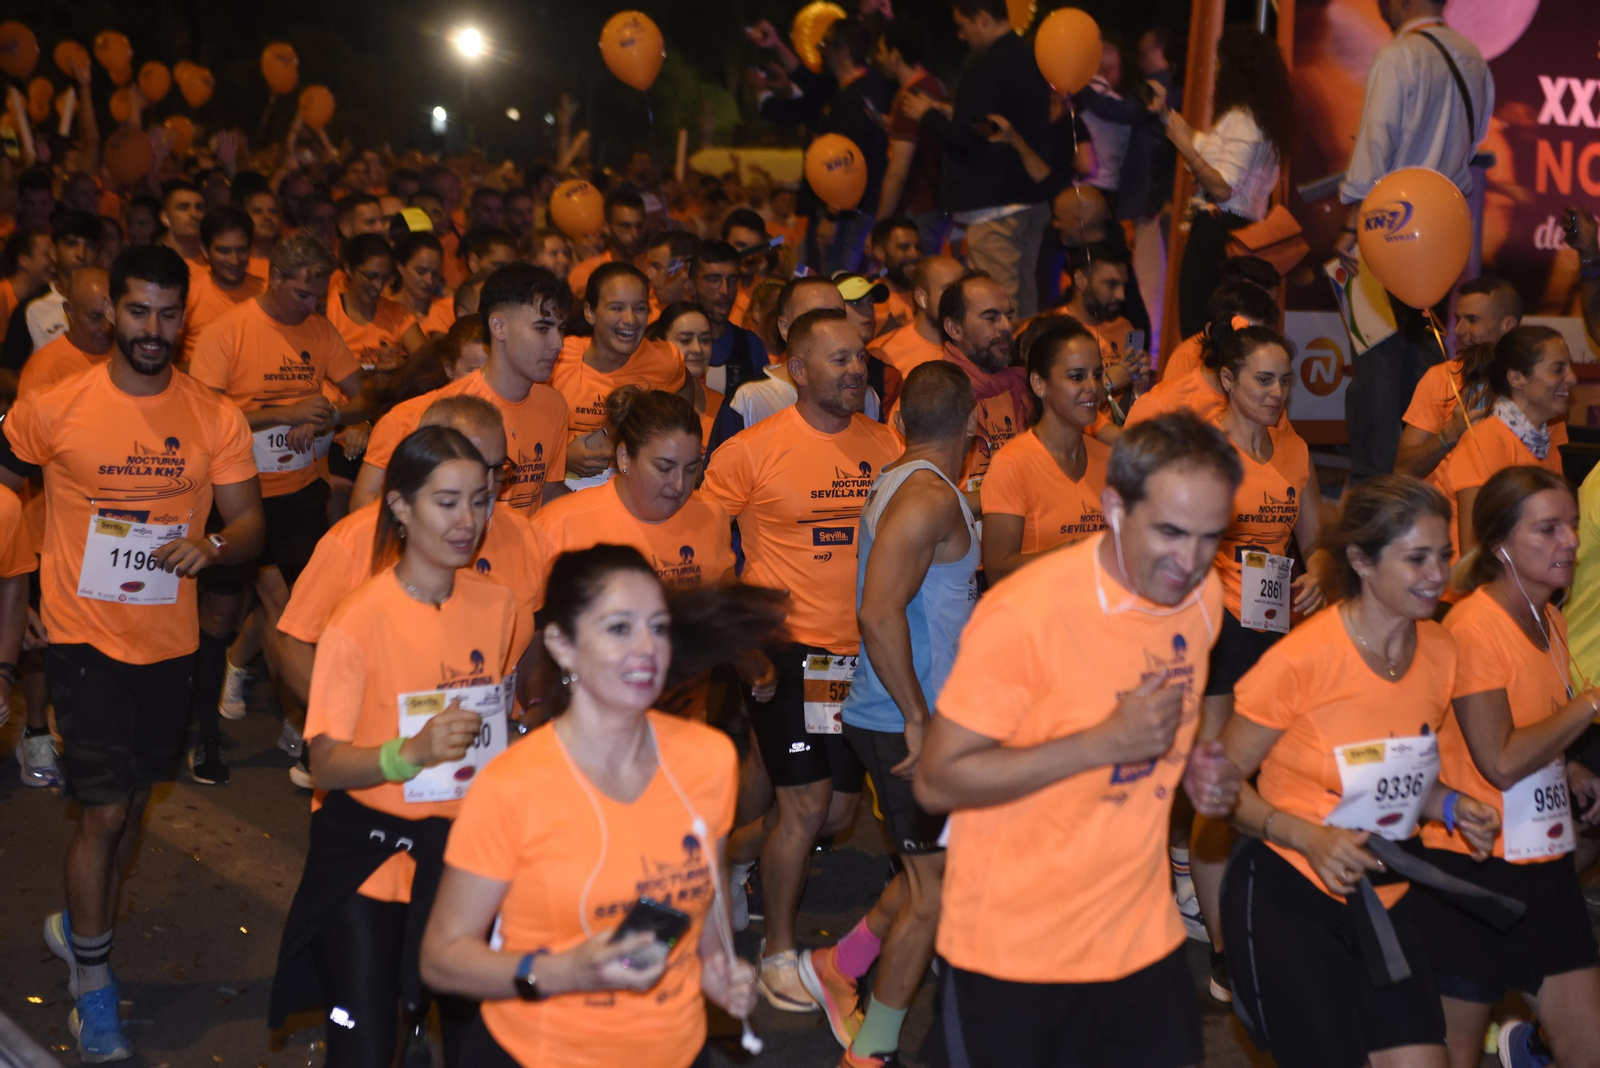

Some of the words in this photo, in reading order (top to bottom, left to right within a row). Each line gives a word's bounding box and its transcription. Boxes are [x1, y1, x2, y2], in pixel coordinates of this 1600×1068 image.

[1537, 75, 1600, 128] XX
[264, 373, 296, 381] SEVILLA
[575, 407, 607, 415] SEVILL
[267, 433, 288, 448] 10
[126, 456, 185, 466] NOCTURNA
[98, 465, 152, 476] SEVILLA
[832, 480, 874, 488] NOCTURN
[810, 489, 855, 499] SEVILLA
[1237, 514, 1276, 523] SEVILLA
[1060, 524, 1098, 534] SEVILLA
[110, 548, 165, 571] 1196
[657, 566, 701, 578] OCTURNA
[1260, 579, 1282, 600] 2861
[1375, 773, 1424, 802] 9336
[1534, 783, 1567, 813] 9563
